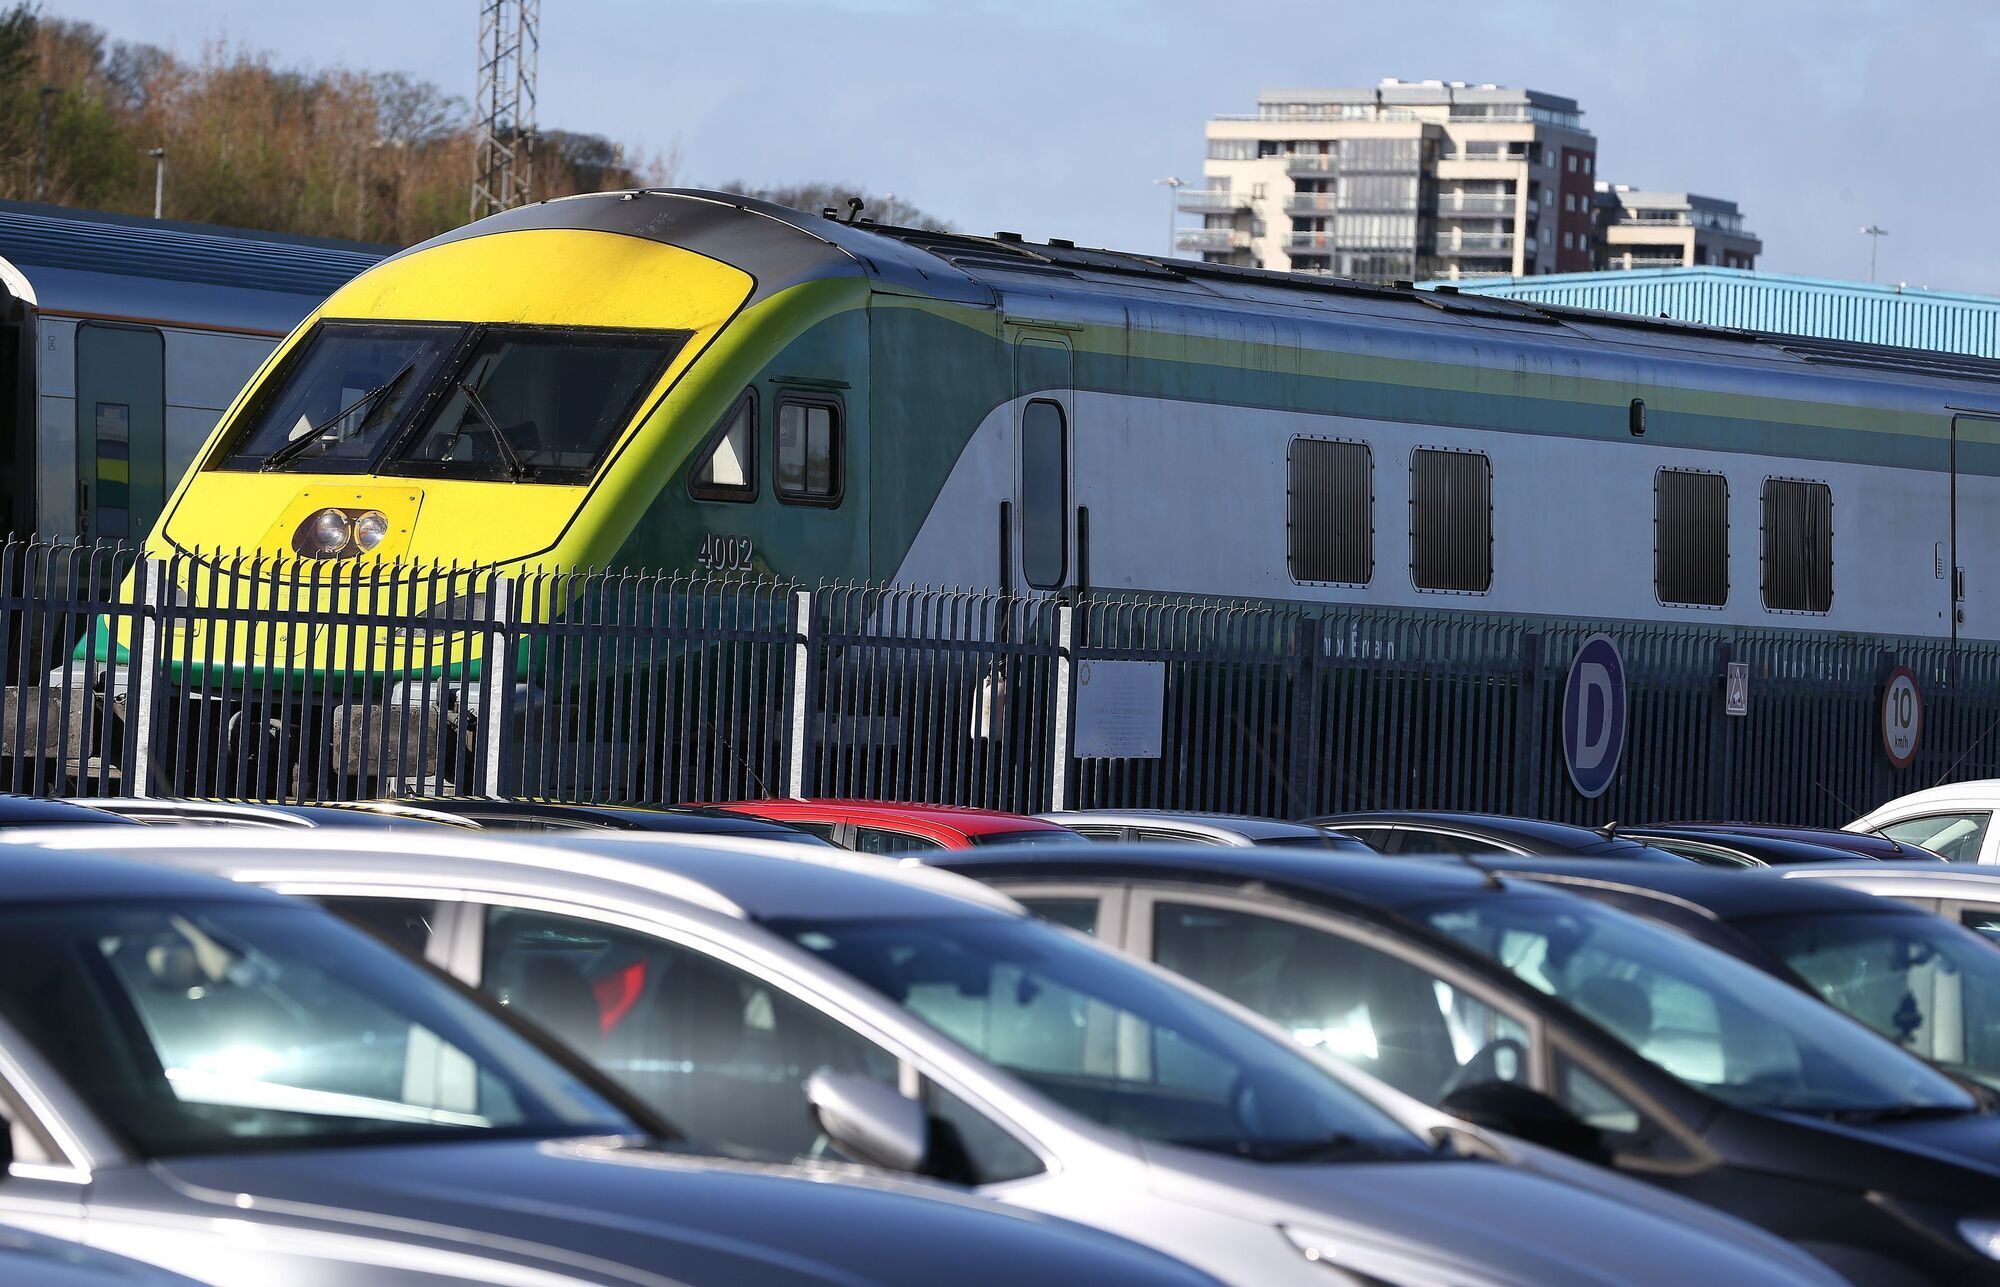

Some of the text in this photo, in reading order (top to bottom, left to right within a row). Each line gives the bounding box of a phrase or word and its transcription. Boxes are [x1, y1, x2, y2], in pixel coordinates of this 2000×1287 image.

[698, 533, 752, 571] 4002
[1576, 663, 1613, 769] D
[1893, 687, 1912, 729] 10
[1894, 735, 1909, 749] km/h
